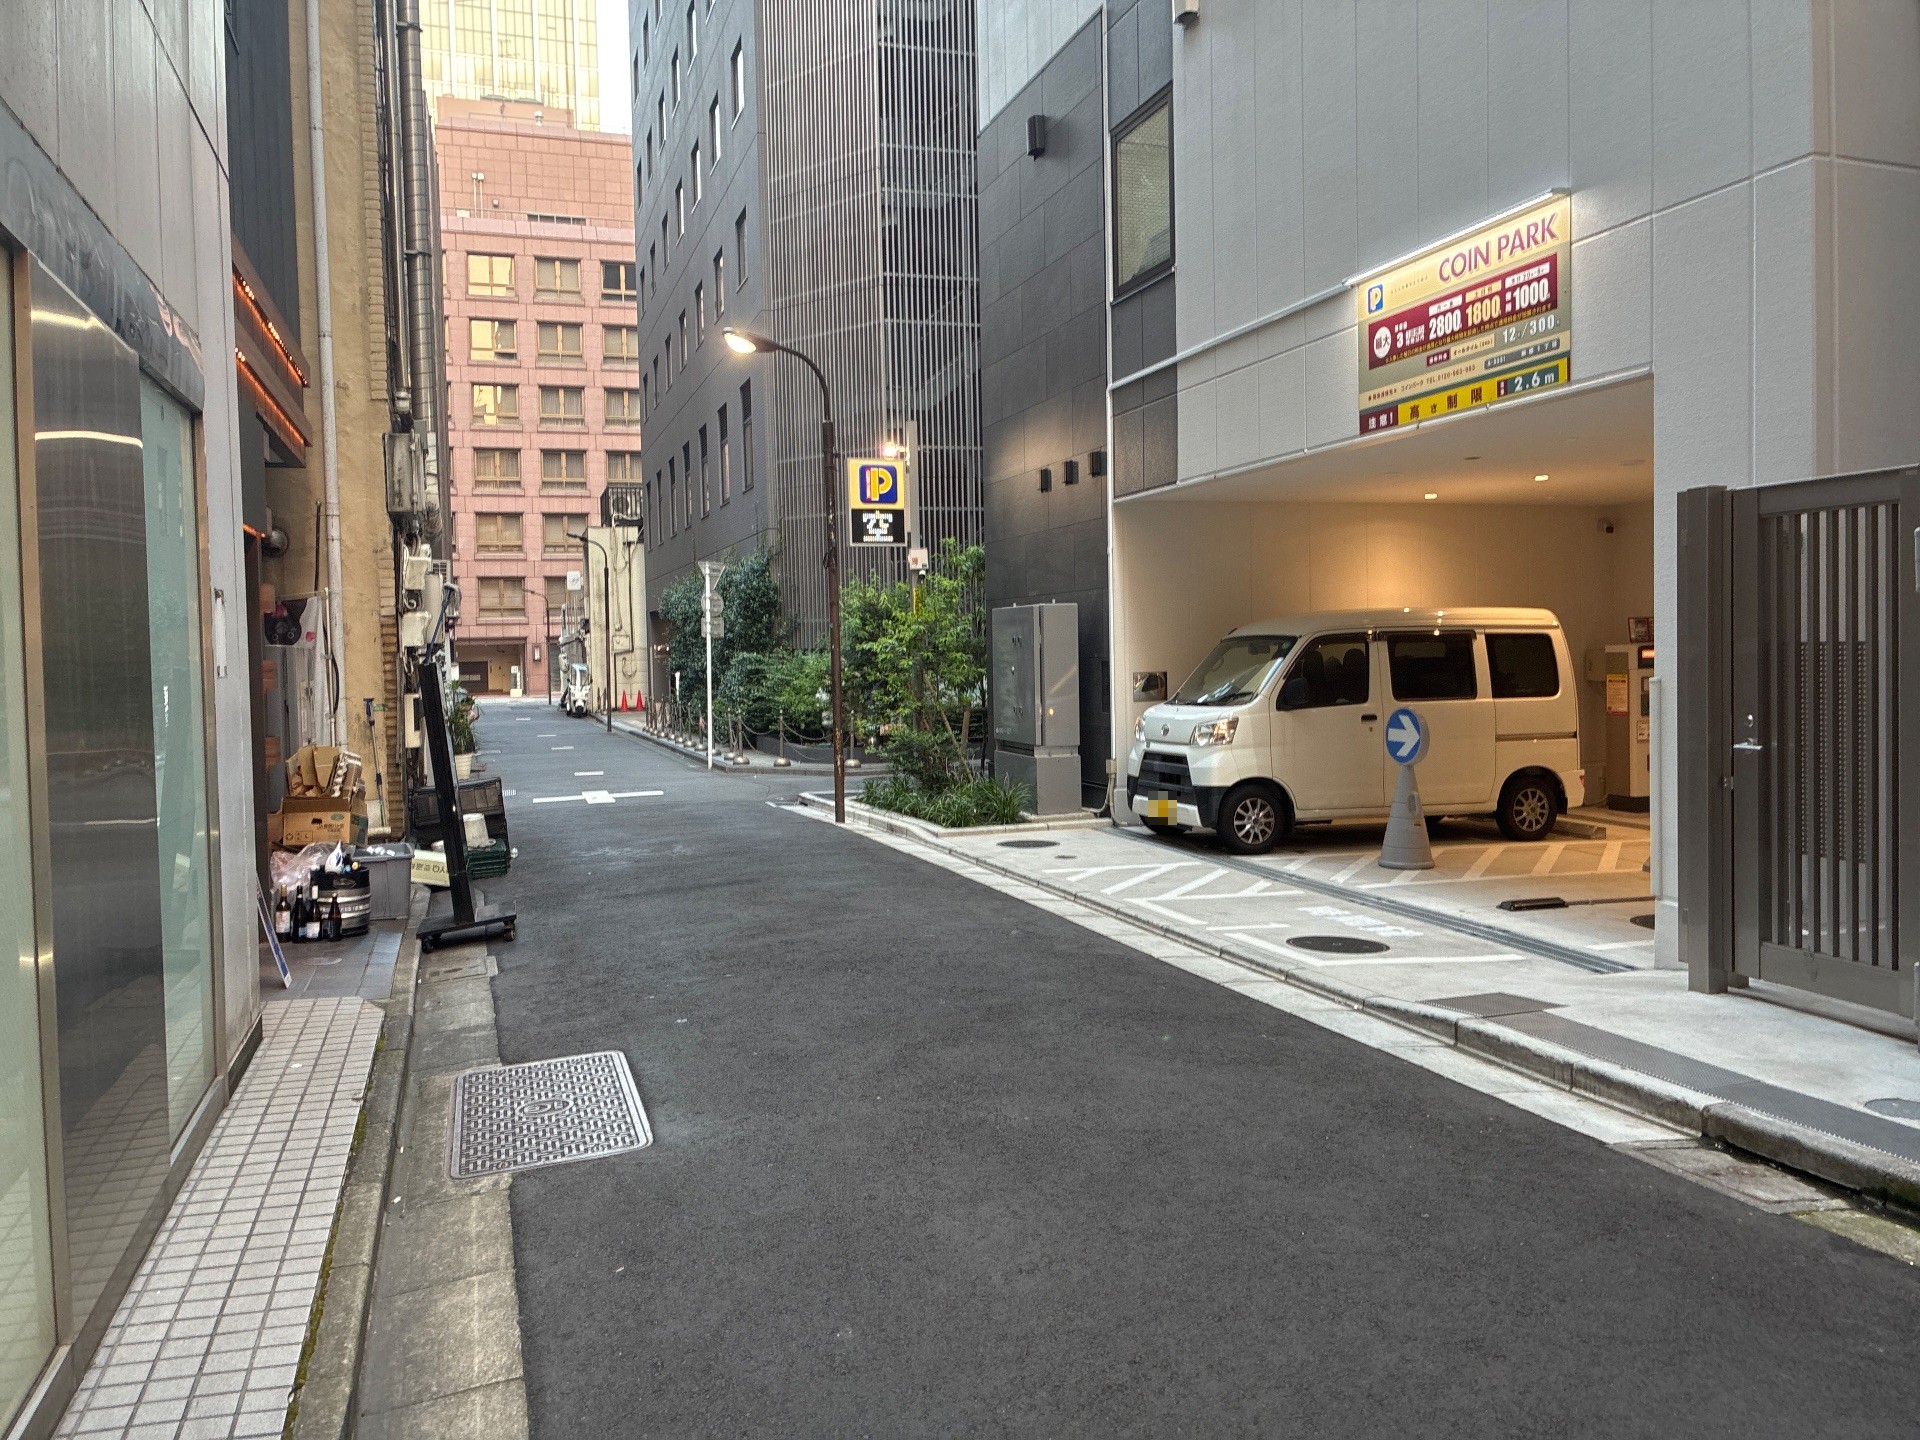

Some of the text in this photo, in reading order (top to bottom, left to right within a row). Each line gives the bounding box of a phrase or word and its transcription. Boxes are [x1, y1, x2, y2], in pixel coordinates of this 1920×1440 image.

[1439, 213, 1558, 283] COIN PARK
[1409, 387, 1483, 421] 高さ制限
